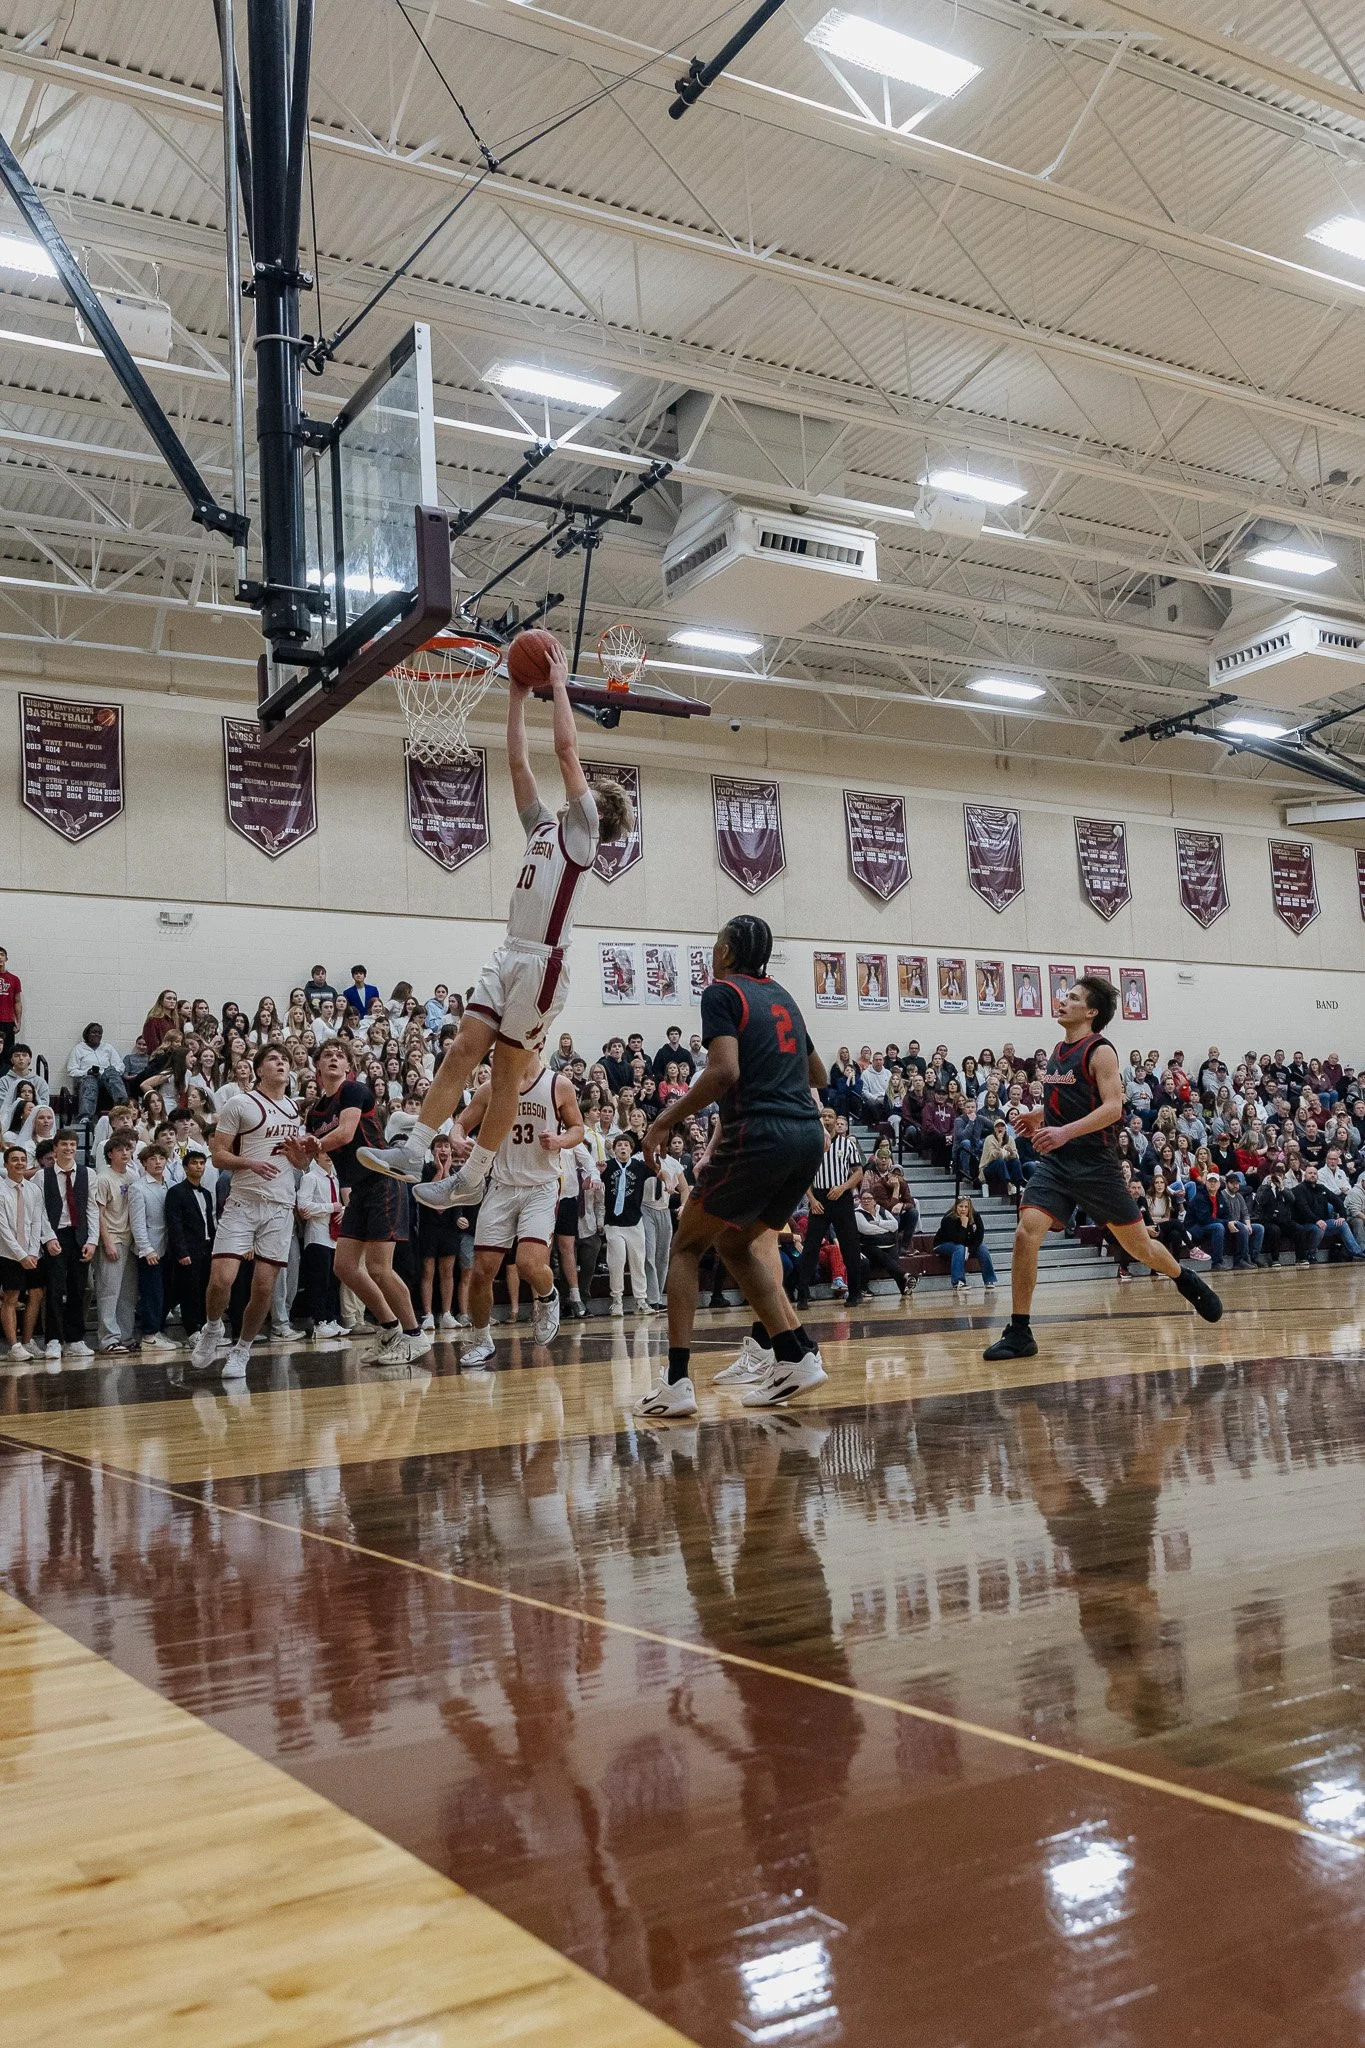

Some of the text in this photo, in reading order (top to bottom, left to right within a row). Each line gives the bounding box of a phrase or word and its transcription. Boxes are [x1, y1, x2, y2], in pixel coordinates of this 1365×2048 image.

[26, 699, 94, 714] BISHOP WATTERSON
[26, 708, 94, 724] BASKETBALL
[230, 732, 253, 742] CROSS
[38, 757, 69, 766] REGIONAL
[270, 780, 302, 789] CHAMPIONS
[269, 798, 302, 807] CHAMPIONS
[516, 864, 536, 889] 10
[602, 948, 618, 996] EAGLES
[646, 949, 660, 996] EAGLES
[1316, 1000, 1338, 1009] BAND
[771, 1004, 796, 1054] 2
[512, 1124, 534, 1144] 33
